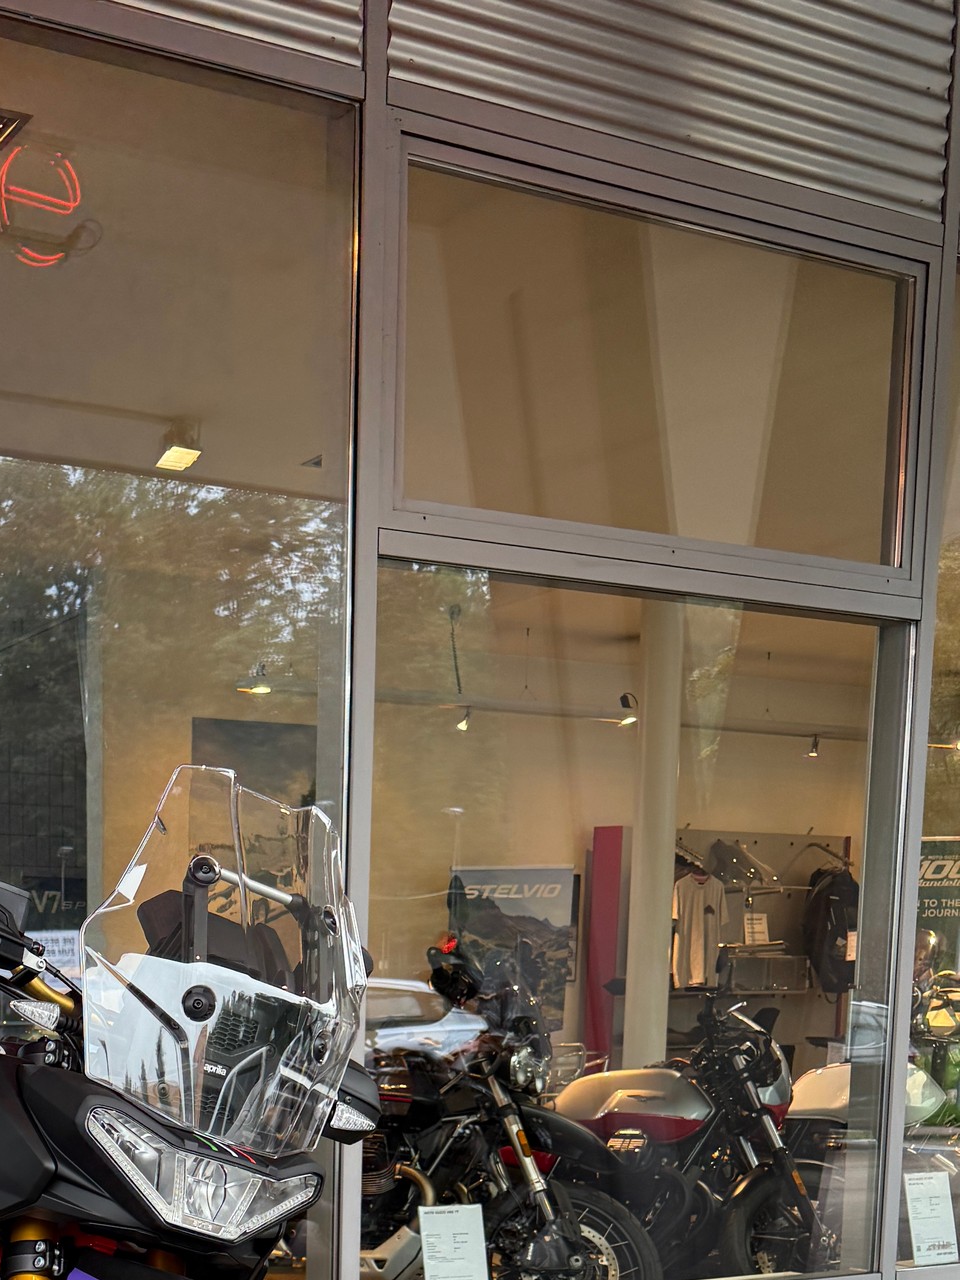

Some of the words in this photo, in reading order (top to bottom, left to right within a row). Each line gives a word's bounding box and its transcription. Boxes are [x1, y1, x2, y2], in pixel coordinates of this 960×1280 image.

[464, 883, 562, 900] STELVIO
[923, 899, 938, 908] TO
[922, 908, 960, 918] JOURN
